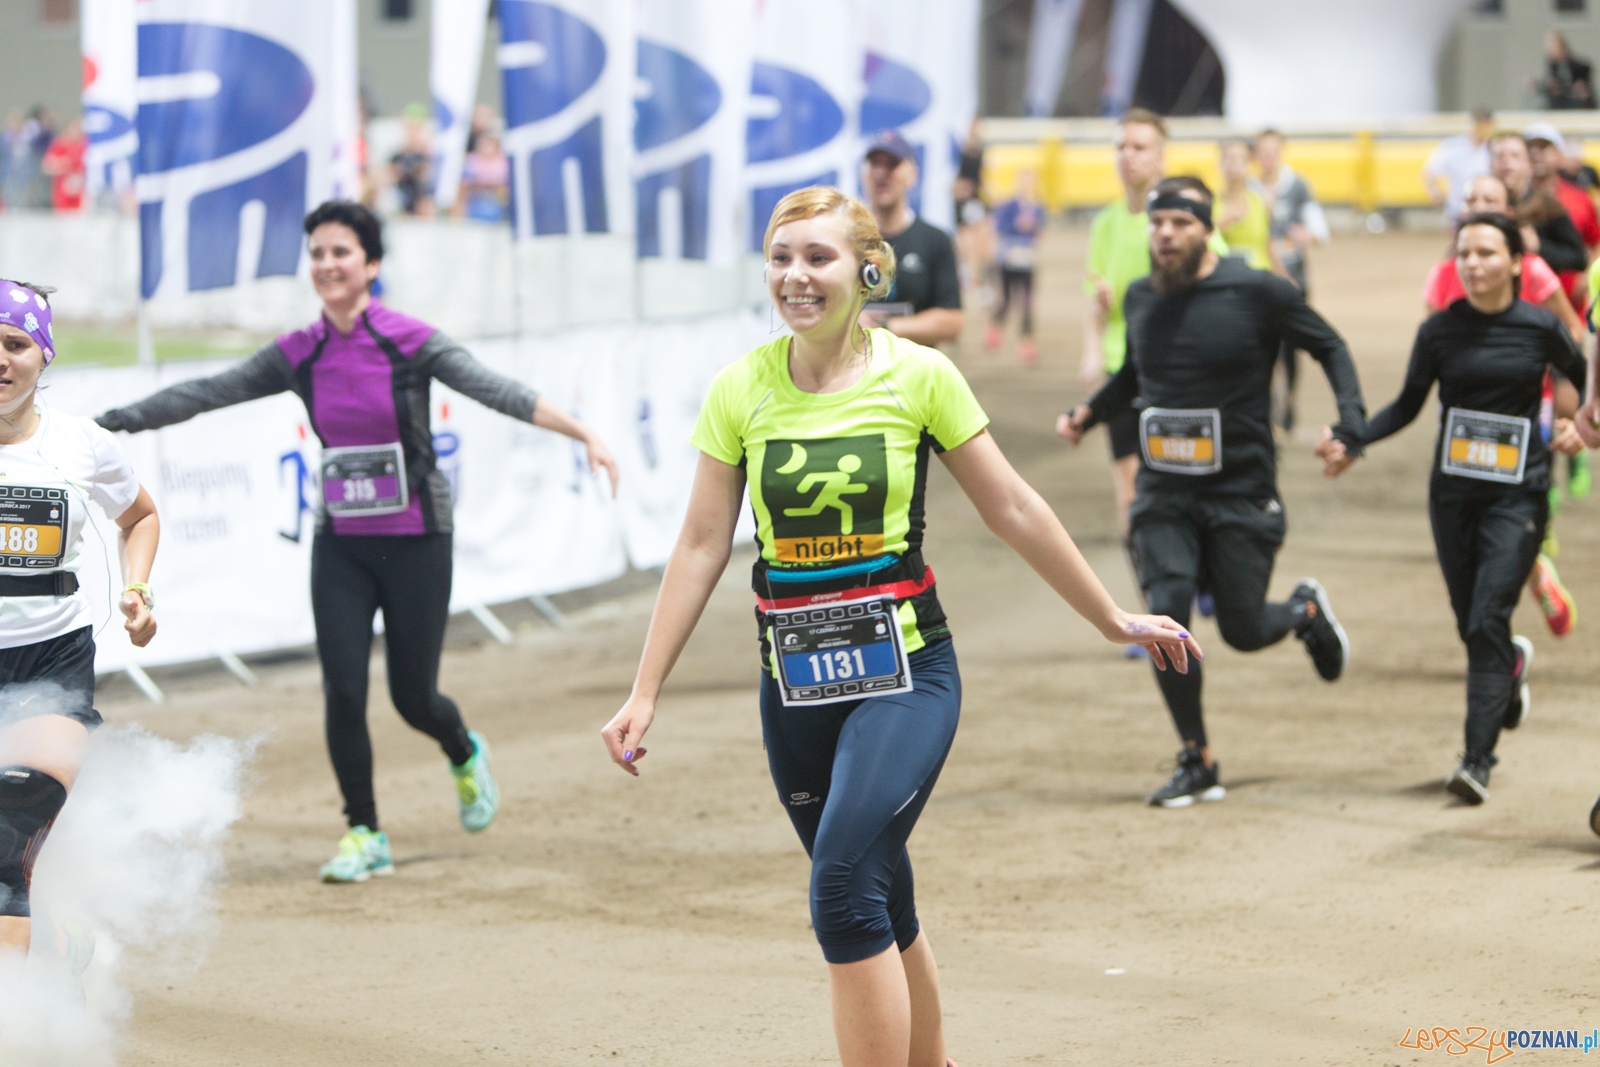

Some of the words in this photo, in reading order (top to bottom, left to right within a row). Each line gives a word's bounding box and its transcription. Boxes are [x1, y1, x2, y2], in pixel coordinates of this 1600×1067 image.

[343, 478, 377, 502] 315
[795, 537, 864, 560] night
[808, 648, 866, 682] 1131
